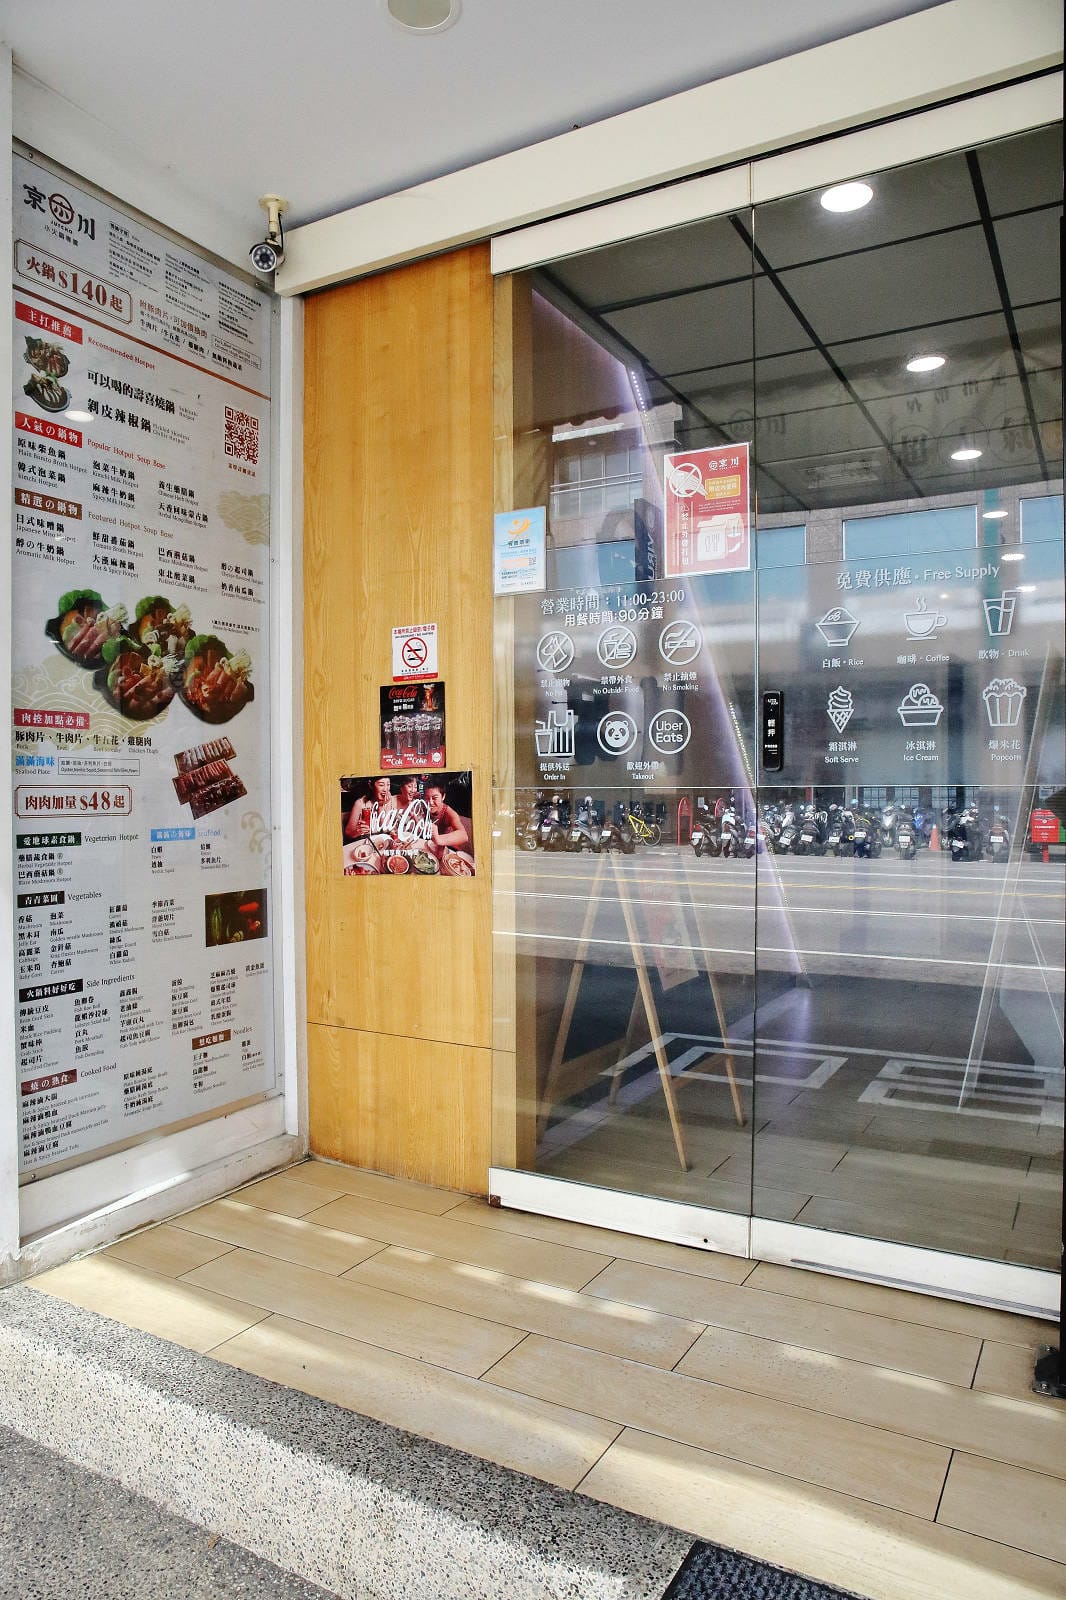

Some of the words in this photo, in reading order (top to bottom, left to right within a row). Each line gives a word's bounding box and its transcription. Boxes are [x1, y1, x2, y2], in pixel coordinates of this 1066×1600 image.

[23, 184, 46, 213] 京
[78, 214, 95, 240] 川
[88, 336, 132, 361] Recommended
[87, 438, 110, 453] Popular
[113, 446, 133, 460] Hotpot
[17, 460, 65, 483] 韓式泡菜鍋
[92, 482, 134, 502] 麻辣牛奶鍋
[16, 512, 64, 533] 日式味噌鍋
[88, 511, 116, 525] Featured
[119, 518, 140, 531] Hotpot
[836, 566, 912, 591] 免費供應
[924, 568, 952, 582] Free
[955, 564, 1001, 579] Supply
[1008, 648, 1030, 657] Drink
[822, 658, 841, 669] 白飯
[848, 657, 864, 666] Rice
[896, 654, 917, 664] 咖啡
[925, 654, 950, 662] Coffee
[672, 683, 699, 691] Smoking
[656, 720, 683, 731] Uber
[656, 733, 683, 743] Eats
[828, 740, 857, 752] 霜淇淋
[906, 740, 936, 752] 冰淇淋
[988, 740, 1021, 751] 爆米花
[824, 755, 839, 764] Soft
[840, 755, 859, 764] Serve
[903, 754, 914, 762] Ice
[916, 753, 939, 762] Cream
[991, 753, 1022, 763] Popcorn
[370, 799, 432, 843] Coca-Cola
[67, 890, 101, 901] Vegetables
[86, 979, 99, 987] Side
[101, 973, 134, 986] Ingredients
[80, 1066, 101, 1077] Cooked
[103, 1062, 116, 1071] Food
